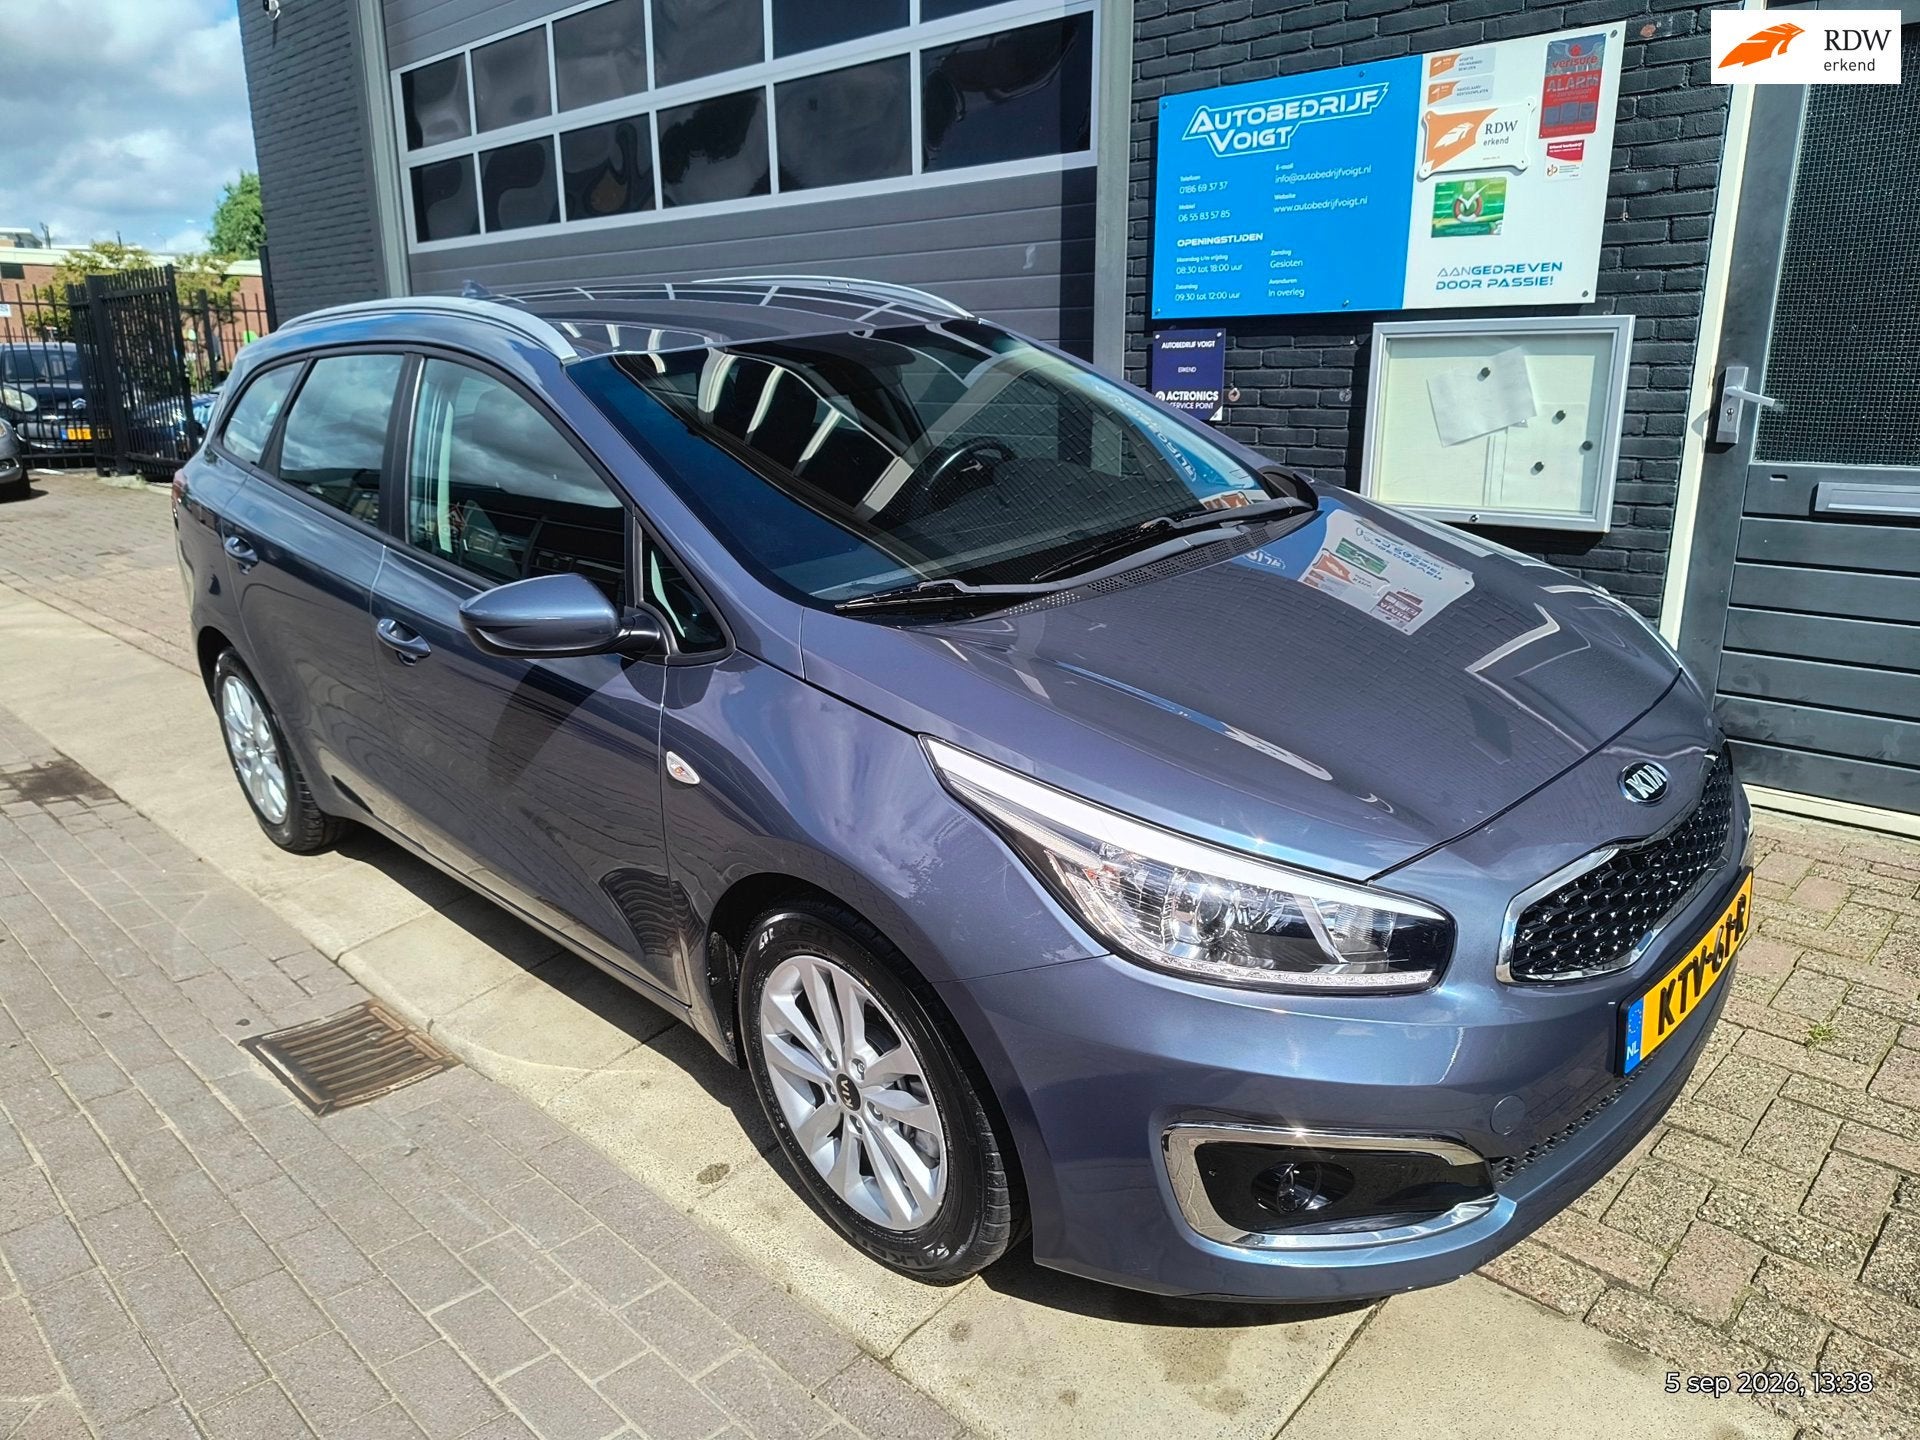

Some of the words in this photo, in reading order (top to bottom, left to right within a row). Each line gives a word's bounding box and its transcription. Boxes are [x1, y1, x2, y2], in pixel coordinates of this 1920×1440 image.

[1552, 55, 1598, 68] verisure
[1548, 75, 1599, 91] ALARM
[1189, 90, 1379, 134] AUTOBEDRIJF
[1485, 120, 1518, 135] RDW
[1210, 126, 1293, 153] VOIGT
[1483, 136, 1509, 146] erkend
[1275, 164, 1372, 184] info@autobedrijfvoigt.nl
[1179, 185, 1197, 194] 0186
[1208, 182, 1218, 191] 37
[1219, 181, 1228, 190] 37
[1273, 196, 1368, 213] www.autobedrijfvoigt.nl
[1178, 213, 1189, 222] 06
[1189, 213, 1199, 221] 55
[1200, 212, 1209, 220] 83
[1210, 211, 1220, 219] 57
[1220, 210, 1231, 218] 85
[1177, 232, 1264, 247] OPENINGSTIJDEN
[1176, 265, 1197, 275] 08:30
[1210, 263, 1230, 272] 18:00
[1270, 259, 1303, 269] Gesloten
[1437, 261, 1563, 277] AANGEDREVEN
[1436, 279, 1482, 290] DOOR
[1487, 276, 1554, 288] PASSIE!
[1175, 292, 1196, 301] 09:30
[1208, 291, 1228, 300] 12:00
[1268, 289, 1276, 297] In
[1276, 287, 1305, 298] overleg
[1161, 341, 1196, 349] AUTOBEDRIJF
[1197, 340, 1216, 348] VOIGT
[1166, 390, 1219, 401] ACTRONICS
[1625, 764, 1668, 799] KIA
[1626, 1040, 1640, 1061] NL
[840, 1079, 854, 1108] KIA
